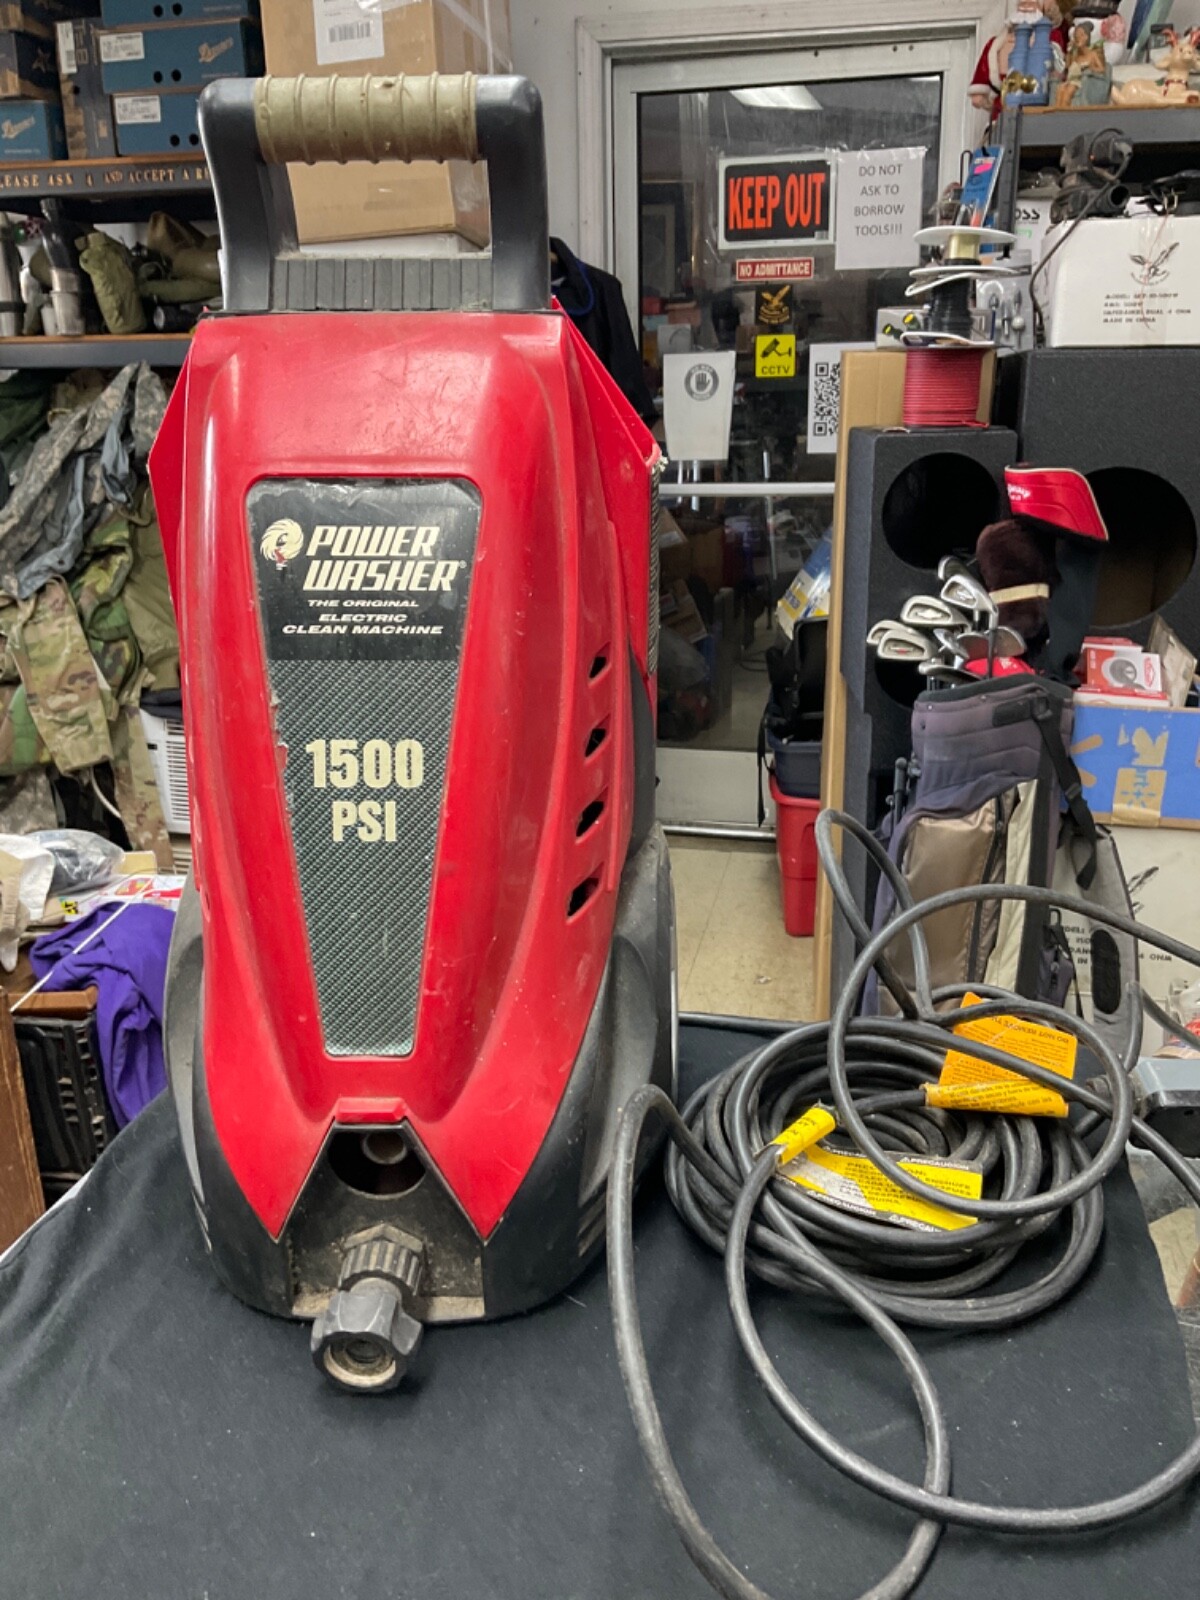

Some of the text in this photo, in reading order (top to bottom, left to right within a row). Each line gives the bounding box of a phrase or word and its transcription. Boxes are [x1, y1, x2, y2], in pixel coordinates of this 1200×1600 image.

[129, 169, 175, 183] ACCEPT
[858, 163, 904, 177] DO NOT
[860, 183, 900, 197] ASK TO
[728, 172, 826, 230] KEEP OUT
[853, 204, 905, 217] BORROW
[855, 223, 903, 236] TOOLS!!!
[739, 262, 811, 277] NO ADMITTANCE
[761, 365, 791, 376] CCTV
[306, 525, 441, 557] POWER
[308, 599, 420, 608] THE ORIGINAL
[318, 613, 408, 623] ELECTRIC
[282, 624, 444, 635] CLEAN MACHINE
[305, 739, 424, 788] 1500
[332, 800, 397, 842] PSI
